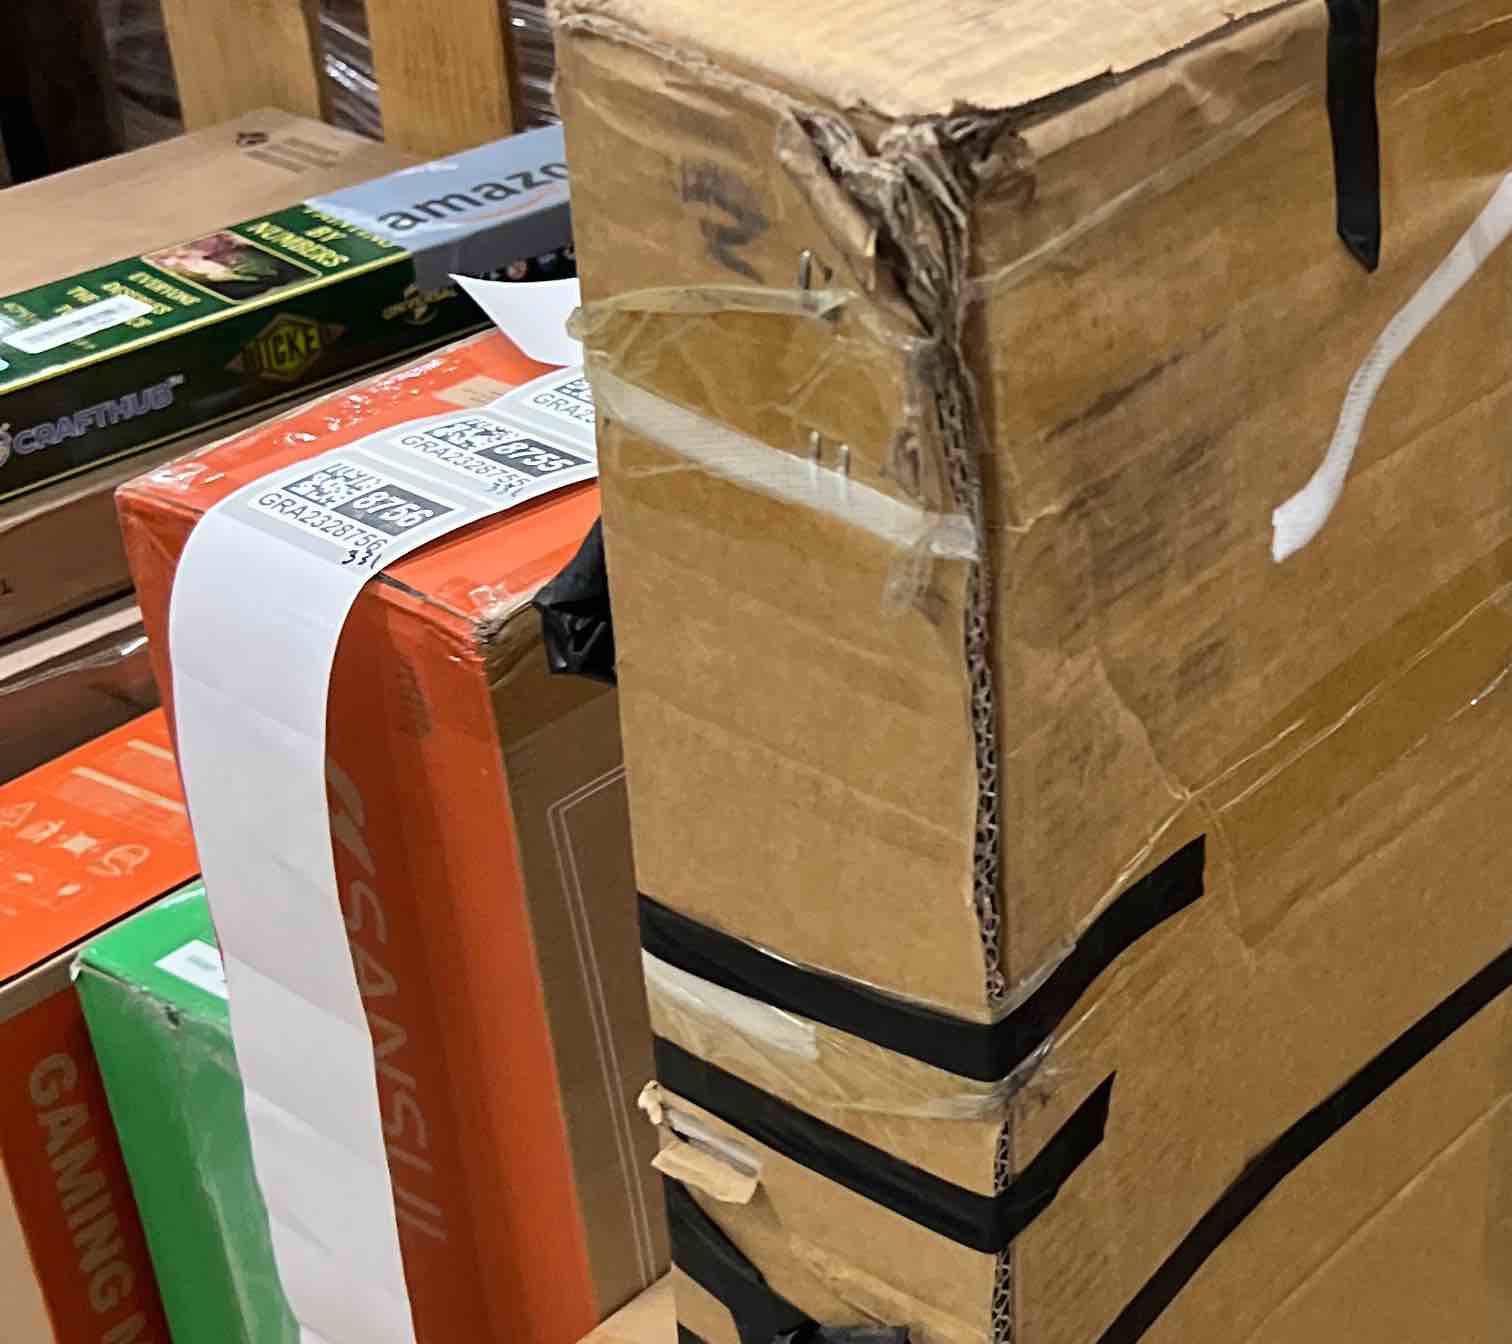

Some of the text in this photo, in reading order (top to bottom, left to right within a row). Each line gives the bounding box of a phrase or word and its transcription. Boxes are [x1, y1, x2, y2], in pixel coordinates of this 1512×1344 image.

[376, 161, 571, 233] amazo
[13, 382, 174, 455] CRAFTHUB
[496, 440, 573, 474] 8755
[258, 493, 387, 552] GRA2328756
[353, 489, 435, 528] 8756
[27, 1053, 135, 1315] GAMING
